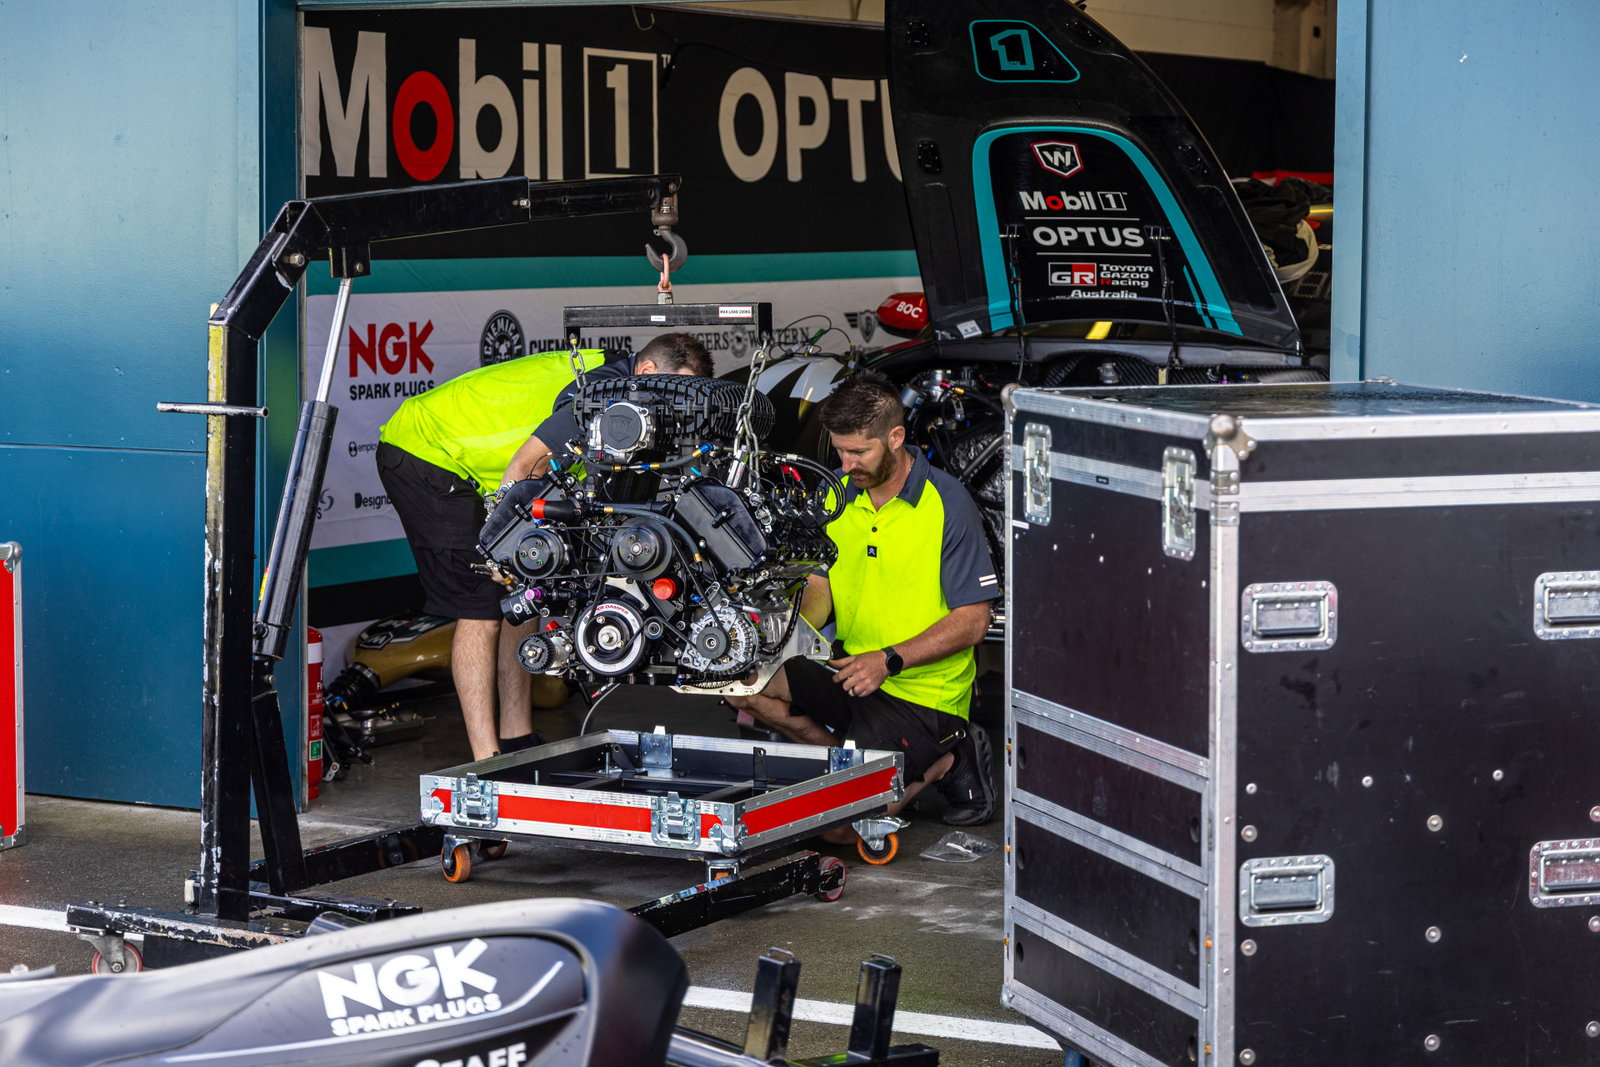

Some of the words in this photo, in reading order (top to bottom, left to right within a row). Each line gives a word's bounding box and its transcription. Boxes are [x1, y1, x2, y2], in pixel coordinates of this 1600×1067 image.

[989, 29, 1035, 71] 1
[304, 26, 564, 181] Mobil
[606, 64, 630, 169] 1
[1018, 190, 1098, 211] Mobil
[1032, 226, 1145, 248] OPTUS
[1051, 271, 1096, 284] GR
[1099, 263, 1154, 272] TOYOTA
[1099, 271, 1150, 279] GAZOO
[1100, 278, 1150, 289] Racing
[1070, 289, 1138, 300] Australia
[896, 300, 923, 319] BOC
[348, 319, 435, 378] NGK
[349, 382, 391, 401] SPARK
[394, 380, 435, 398] PLUGS
[317, 937, 498, 1020] NGK
[330, 1009, 415, 1037] SPARK
[416, 993, 502, 1023] PLUGS
